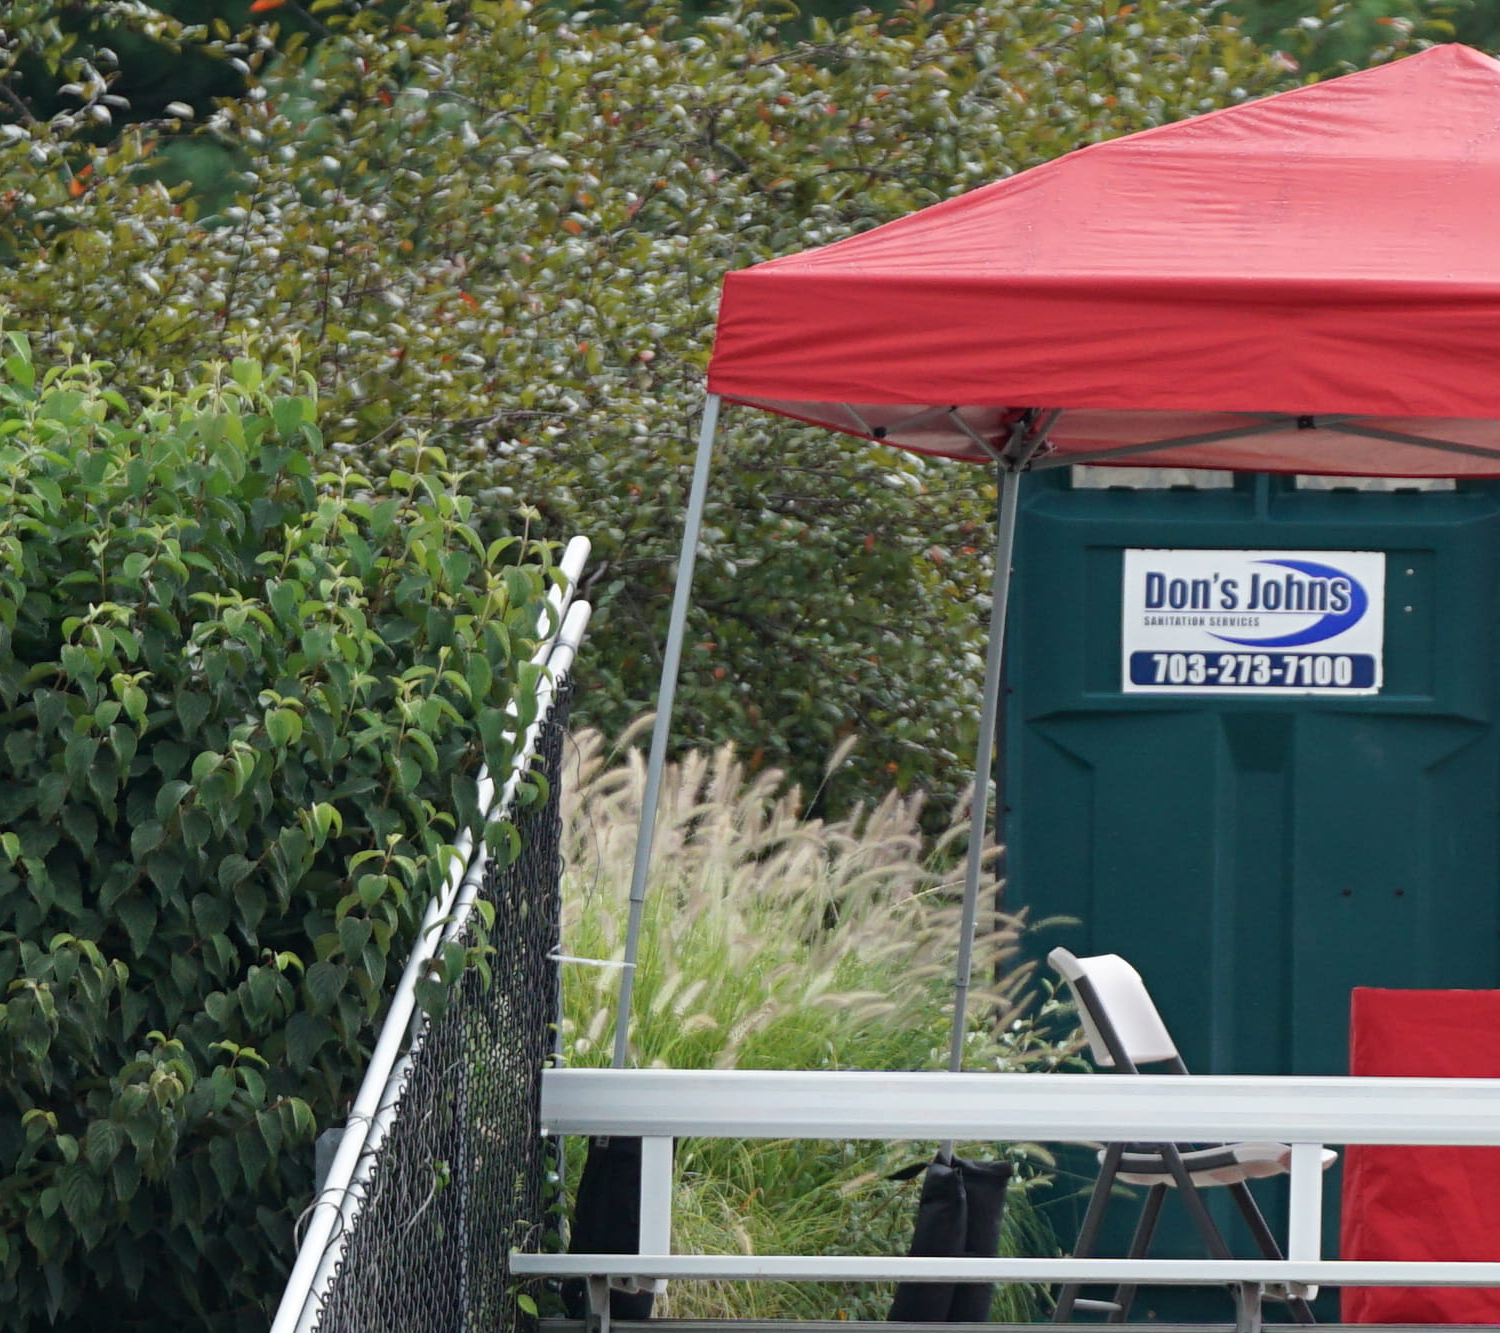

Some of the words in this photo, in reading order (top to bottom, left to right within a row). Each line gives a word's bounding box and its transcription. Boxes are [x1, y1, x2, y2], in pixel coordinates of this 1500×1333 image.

[1145, 571, 1239, 610] Don's
[1247, 573, 1351, 613] Johns
[1143, 616, 1206, 628] SANITATION
[1208, 616, 1260, 628] SERVICES
[1152, 653, 1353, 686] 703-273-7100
